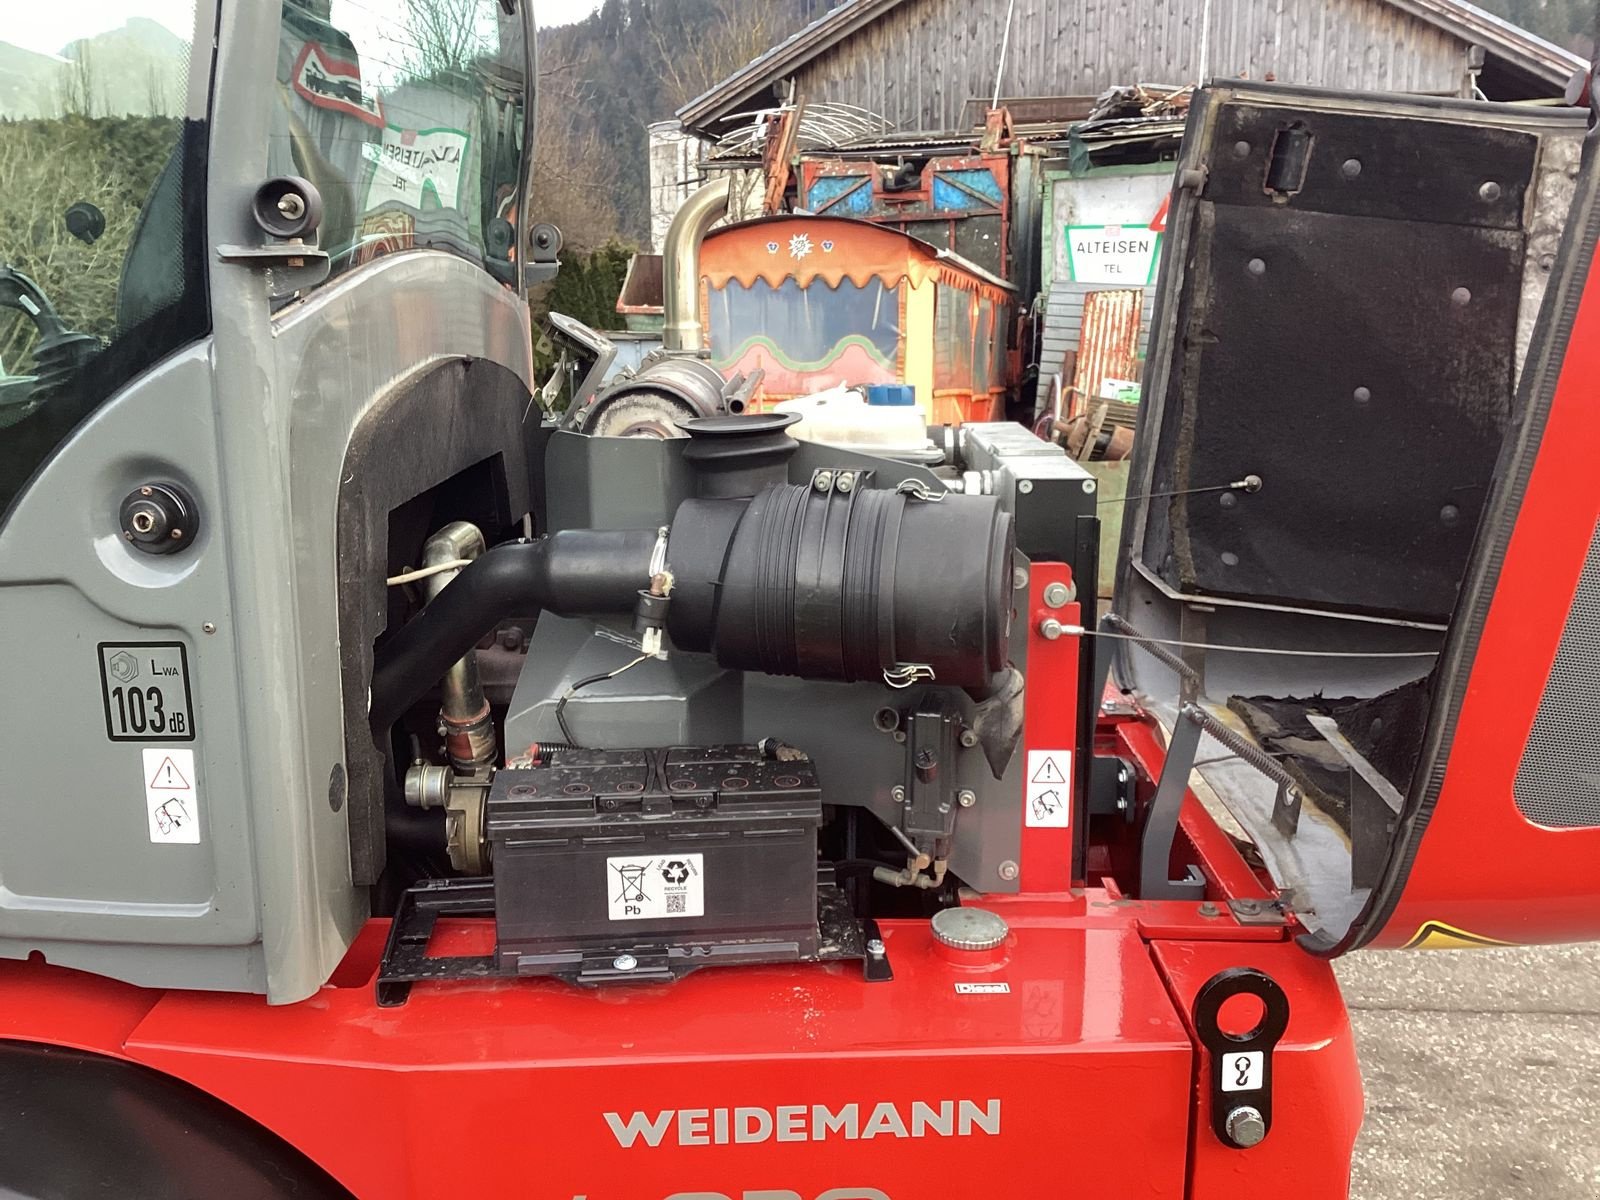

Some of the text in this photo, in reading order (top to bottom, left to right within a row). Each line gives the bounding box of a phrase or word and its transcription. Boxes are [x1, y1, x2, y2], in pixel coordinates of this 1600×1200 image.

[1077, 240, 1149, 253] ALTEISEN
[1104, 264, 1122, 273] TEL
[112, 686, 186, 733] 103 dB
[624, 905, 641, 915] Pb
[603, 1099, 1000, 1148] WEIDEMANN
